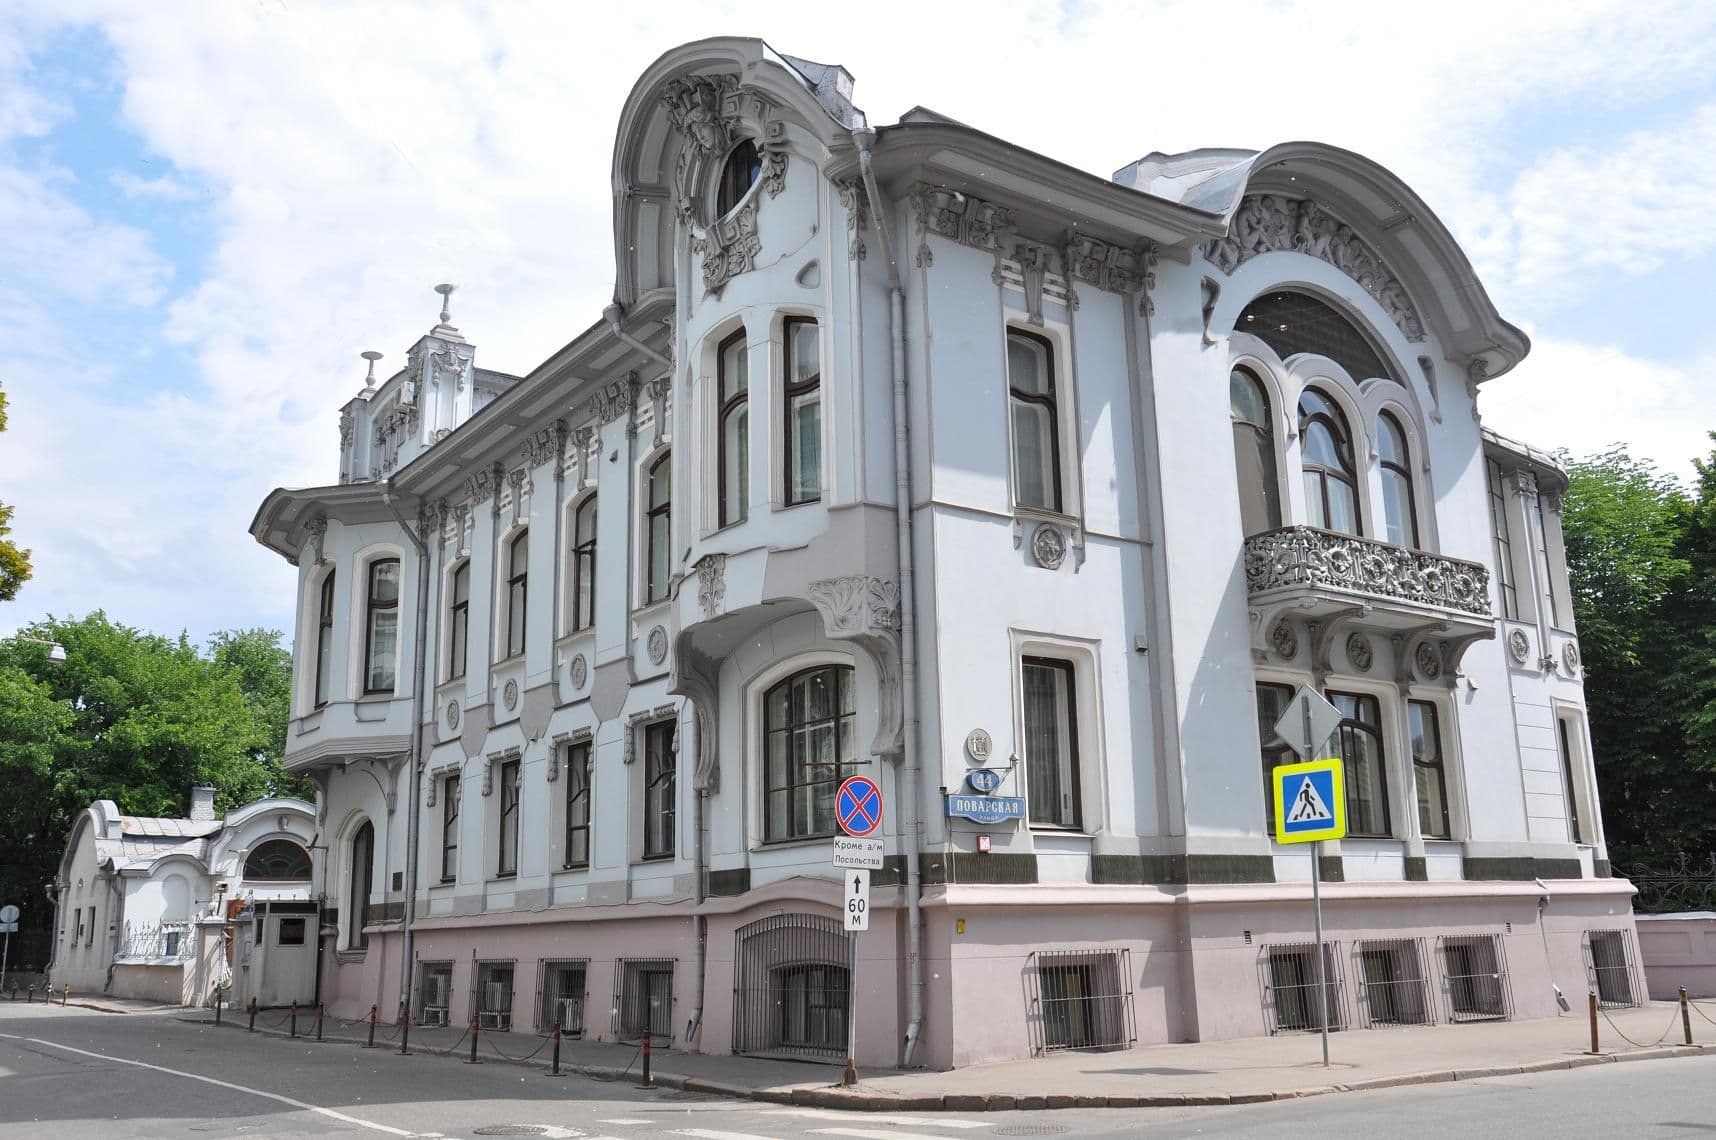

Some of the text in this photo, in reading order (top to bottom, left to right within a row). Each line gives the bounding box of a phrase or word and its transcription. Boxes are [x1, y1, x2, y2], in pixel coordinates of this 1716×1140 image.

[976, 774, 993, 785] 44
[957, 799, 1018, 813] ПОВАРСКАЯ
[835, 840, 883, 852] Кроме а/м
[835, 855, 880, 865] Посольства
[848, 898, 865, 913] 60
